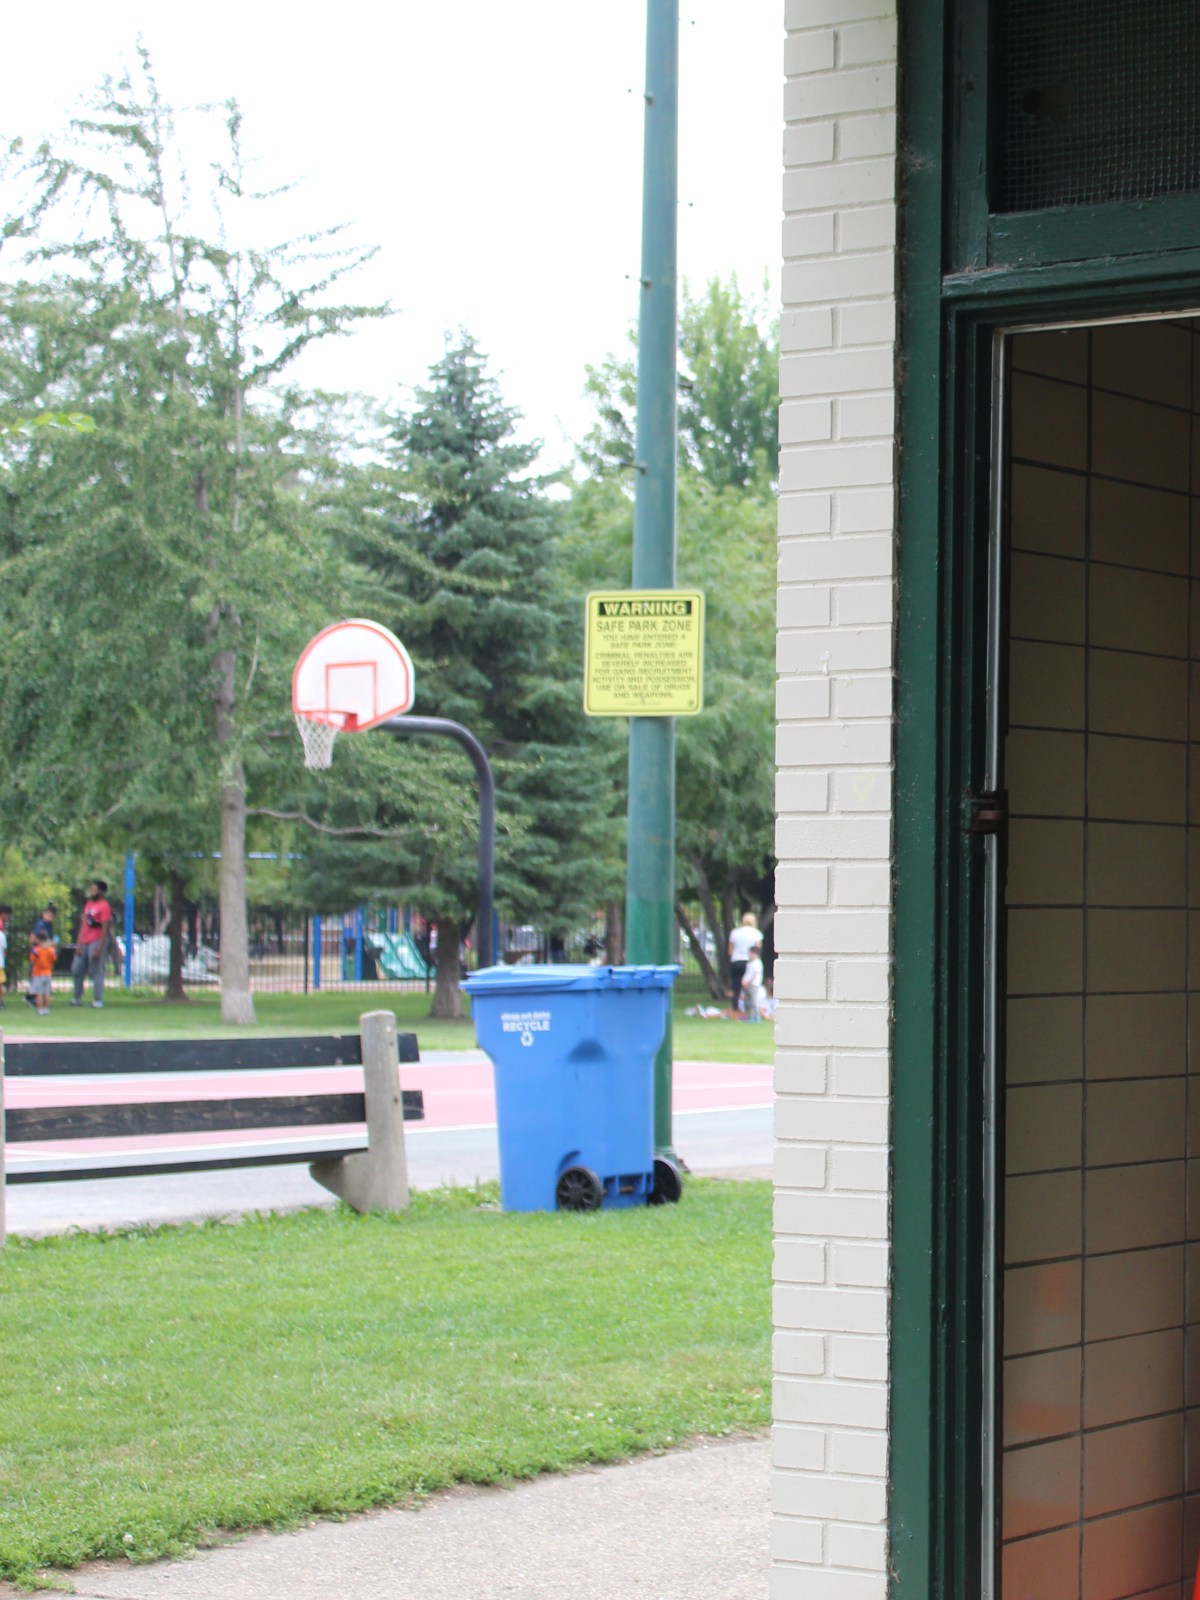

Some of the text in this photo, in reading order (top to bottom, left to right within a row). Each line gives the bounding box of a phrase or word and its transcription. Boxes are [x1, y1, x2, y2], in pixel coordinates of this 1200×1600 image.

[603, 602, 687, 615] WARNING
[596, 620, 692, 632] SAFE PARK ZONE
[502, 1020, 550, 1032] RECYCLE
